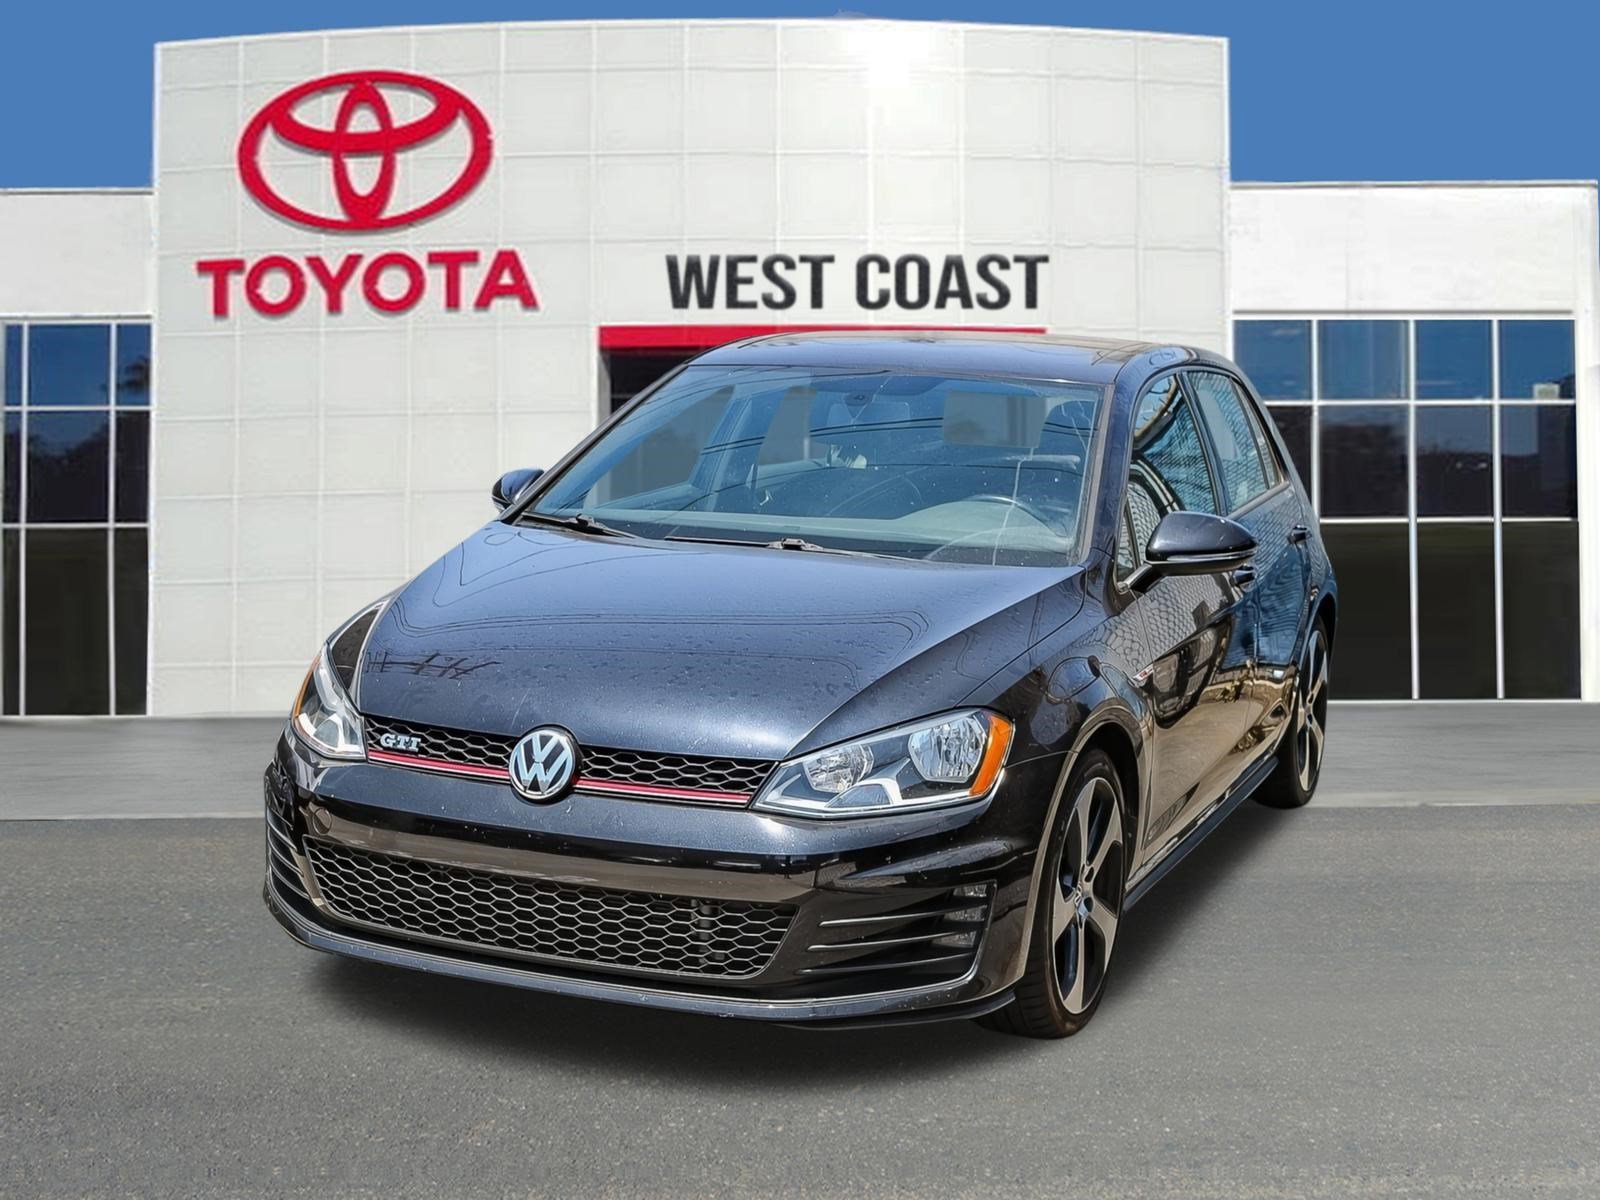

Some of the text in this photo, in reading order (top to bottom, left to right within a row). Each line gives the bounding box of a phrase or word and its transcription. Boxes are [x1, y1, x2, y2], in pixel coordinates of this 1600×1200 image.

[196, 249, 539, 318] TOYOTA
[666, 253, 1049, 310] WEST COAST
[380, 733, 421, 752] GTI
[511, 730, 574, 797] VW
